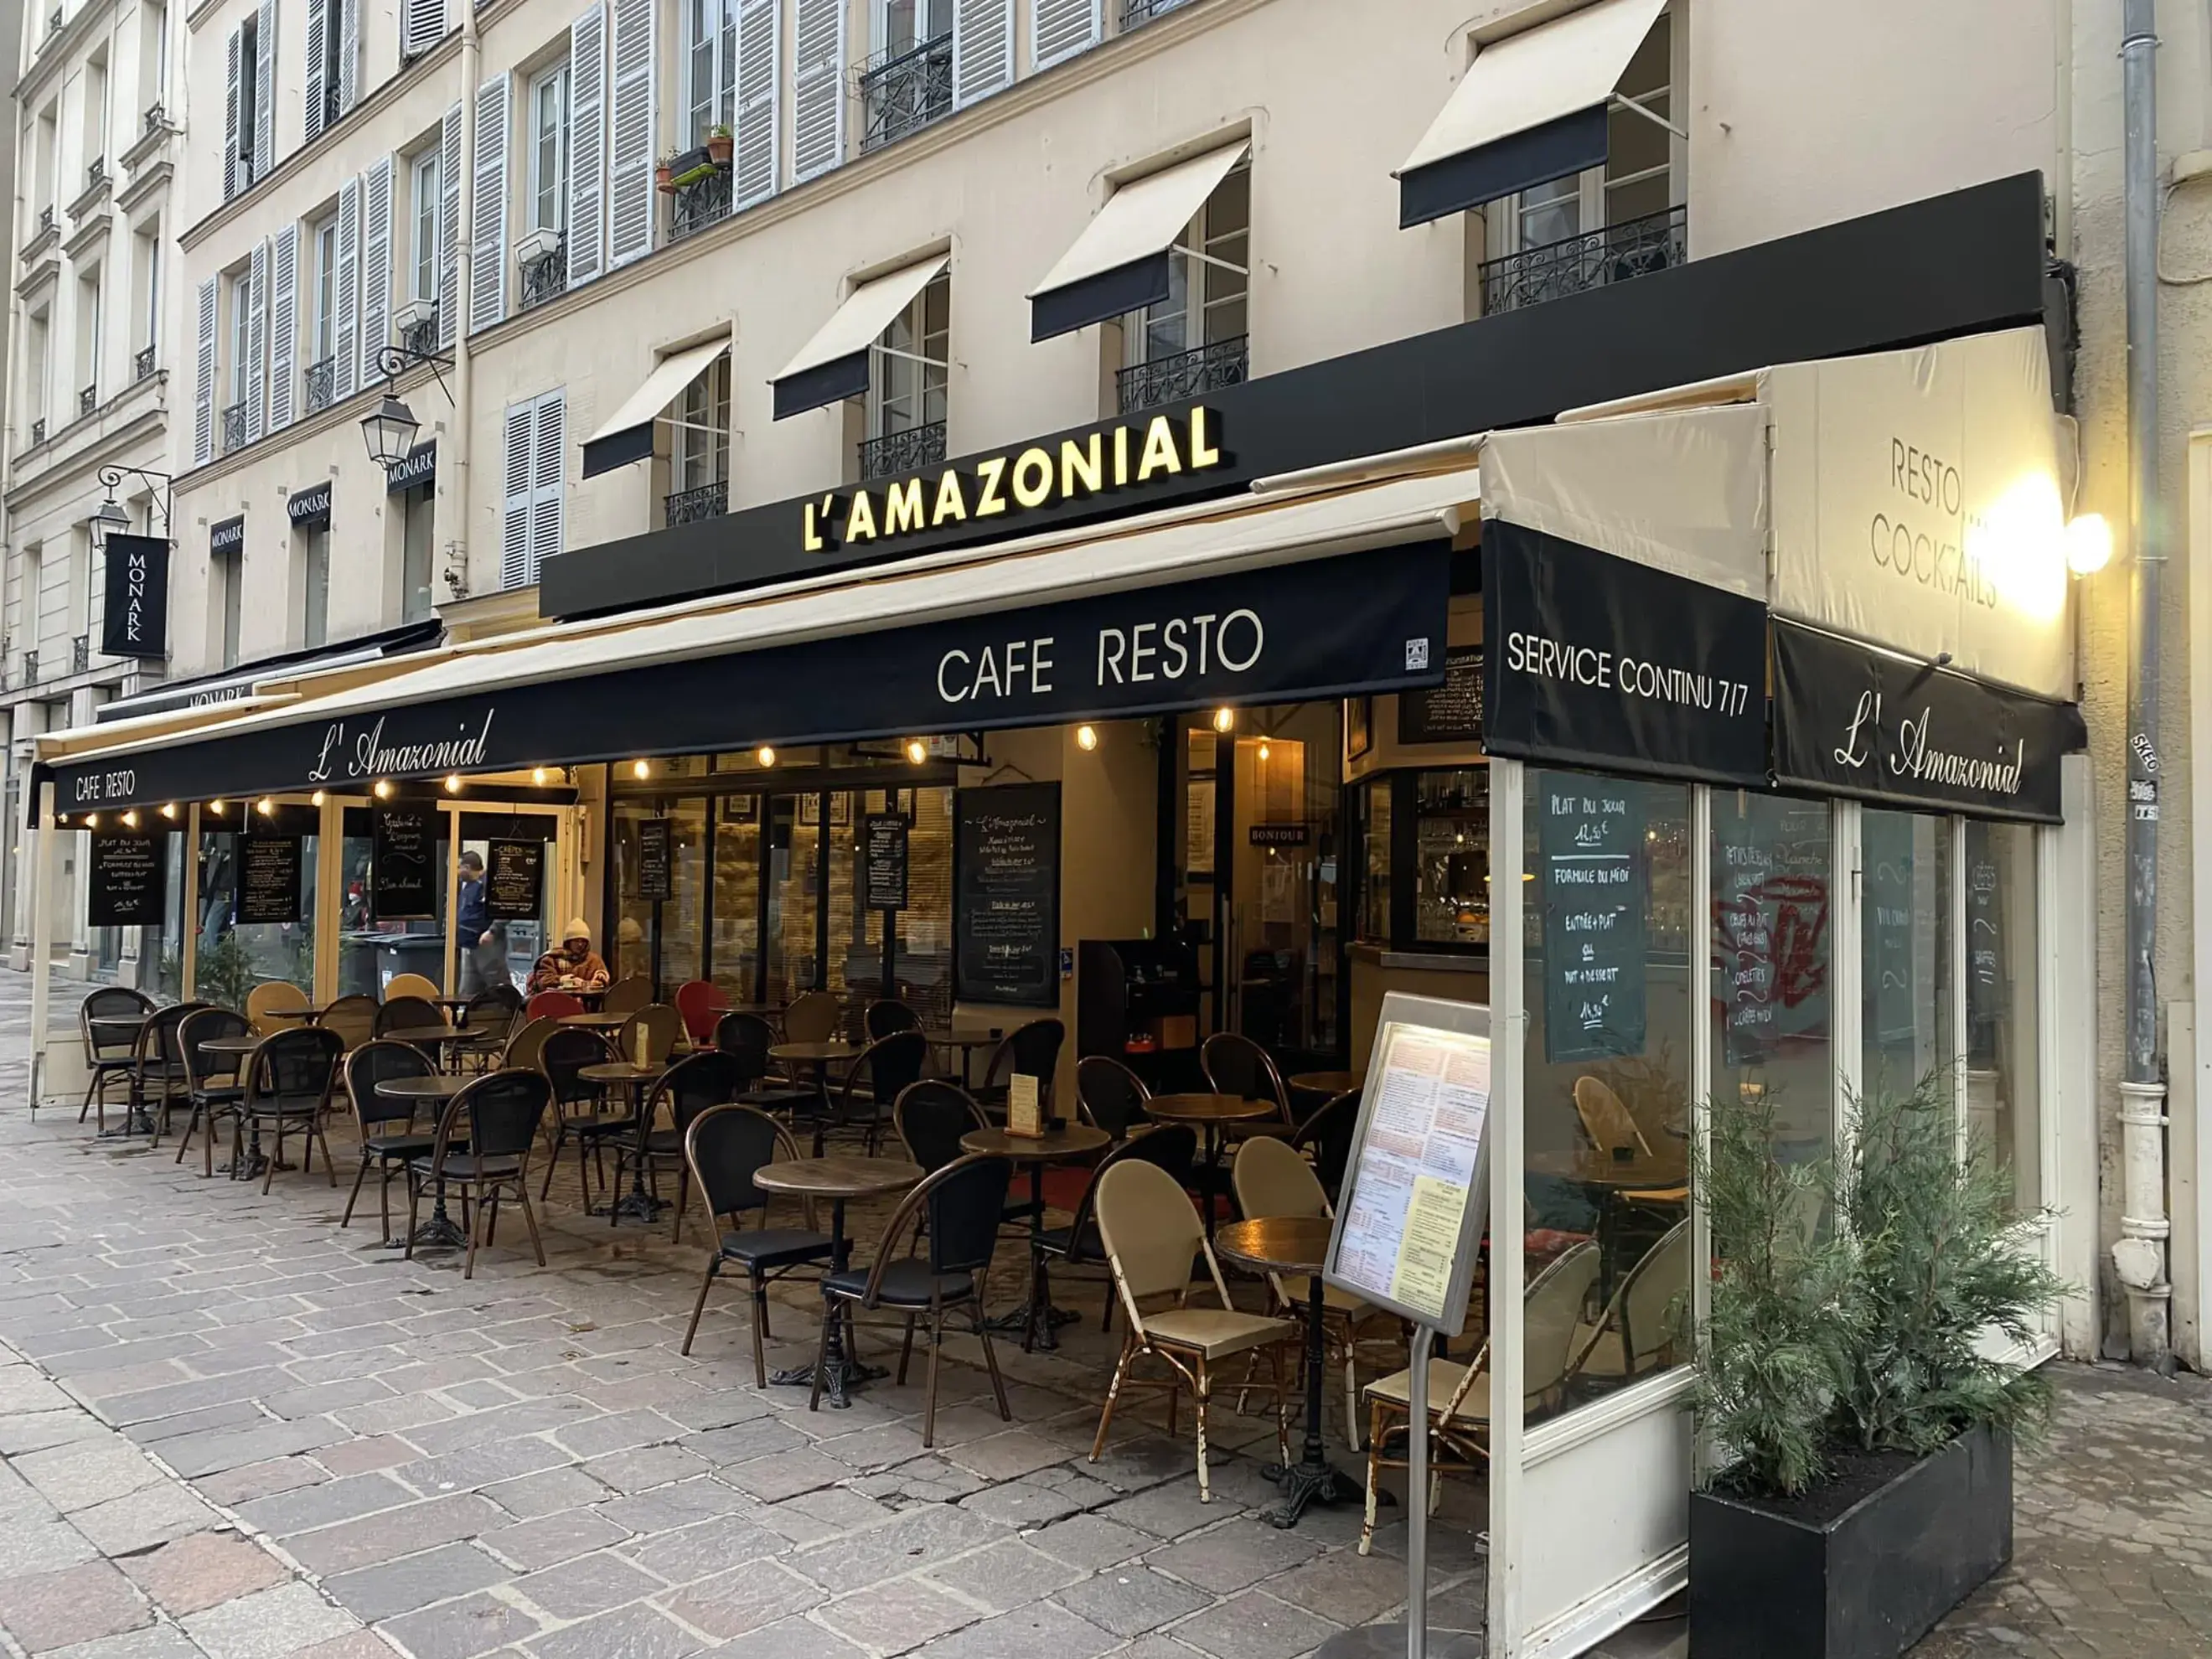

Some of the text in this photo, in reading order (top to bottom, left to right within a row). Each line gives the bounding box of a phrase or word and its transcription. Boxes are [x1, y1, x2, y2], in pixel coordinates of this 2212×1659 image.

[388, 451, 434, 484] MONARK
[804, 406, 1218, 551] L'AMAZONIAL
[289, 491, 330, 517] MONARK
[212, 524, 243, 547] MONARK
[127, 553, 147, 642] MONARK
[938, 608, 1264, 703] CAFE RESTO
[1508, 632, 1611, 688] SERVICE
[1619, 658, 1713, 709] CONTINU
[348, 708, 495, 778] Amazonial
[1890, 707, 2024, 795] Amazonial
[75, 770, 135, 801] CAFE RESTO
[1551, 794, 1625, 815] PLAT DU JOUR
[1252, 830, 1305, 841] BONJOUR
[1554, 868, 1595, 885] FORMULE
[1598, 869, 1609, 884] DU
